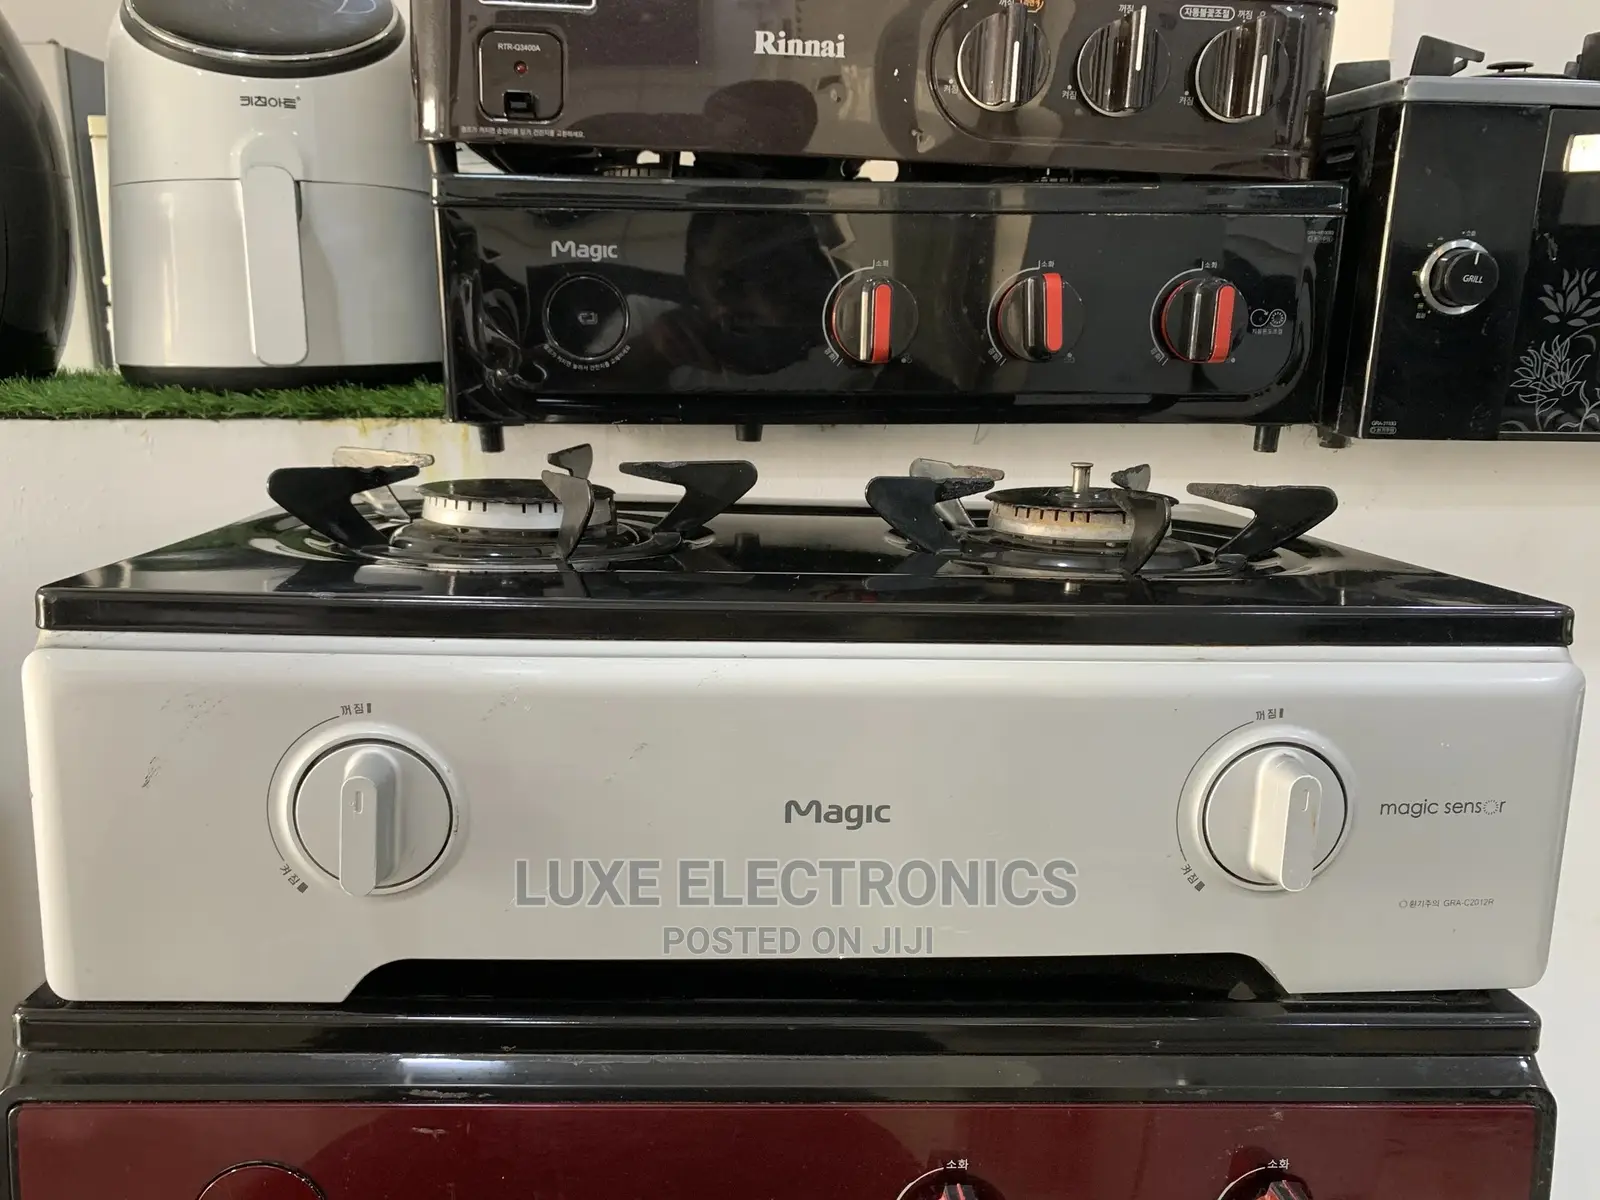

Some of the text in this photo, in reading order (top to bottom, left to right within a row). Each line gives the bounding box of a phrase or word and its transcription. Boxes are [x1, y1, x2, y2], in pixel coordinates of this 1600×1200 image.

[1118, 4, 1135, 14] 꺼짐
[1237, 9, 1253, 20] 꺼짐
[497, 42, 541, 52] RTR-Q3400A
[753, 30, 845, 58] Rinnai
[1061, 89, 1077, 100] 켜짐
[551, 240, 618, 262] Magic
[1462, 274, 1484, 284] GRILL
[340, 703, 364, 716] 꺼짐
[1255, 708, 1277, 721] 꺼짐
[784, 800, 891, 830] Magic
[1380, 799, 1439, 818] magic
[279, 862, 300, 886] 켜짐
[1180, 862, 1200, 885] 켜짐
[1443, 897, 1495, 907] GRA-C2012R
[946, 1158, 969, 1171] 소화
[1267, 1158, 1290, 1170] 소화
